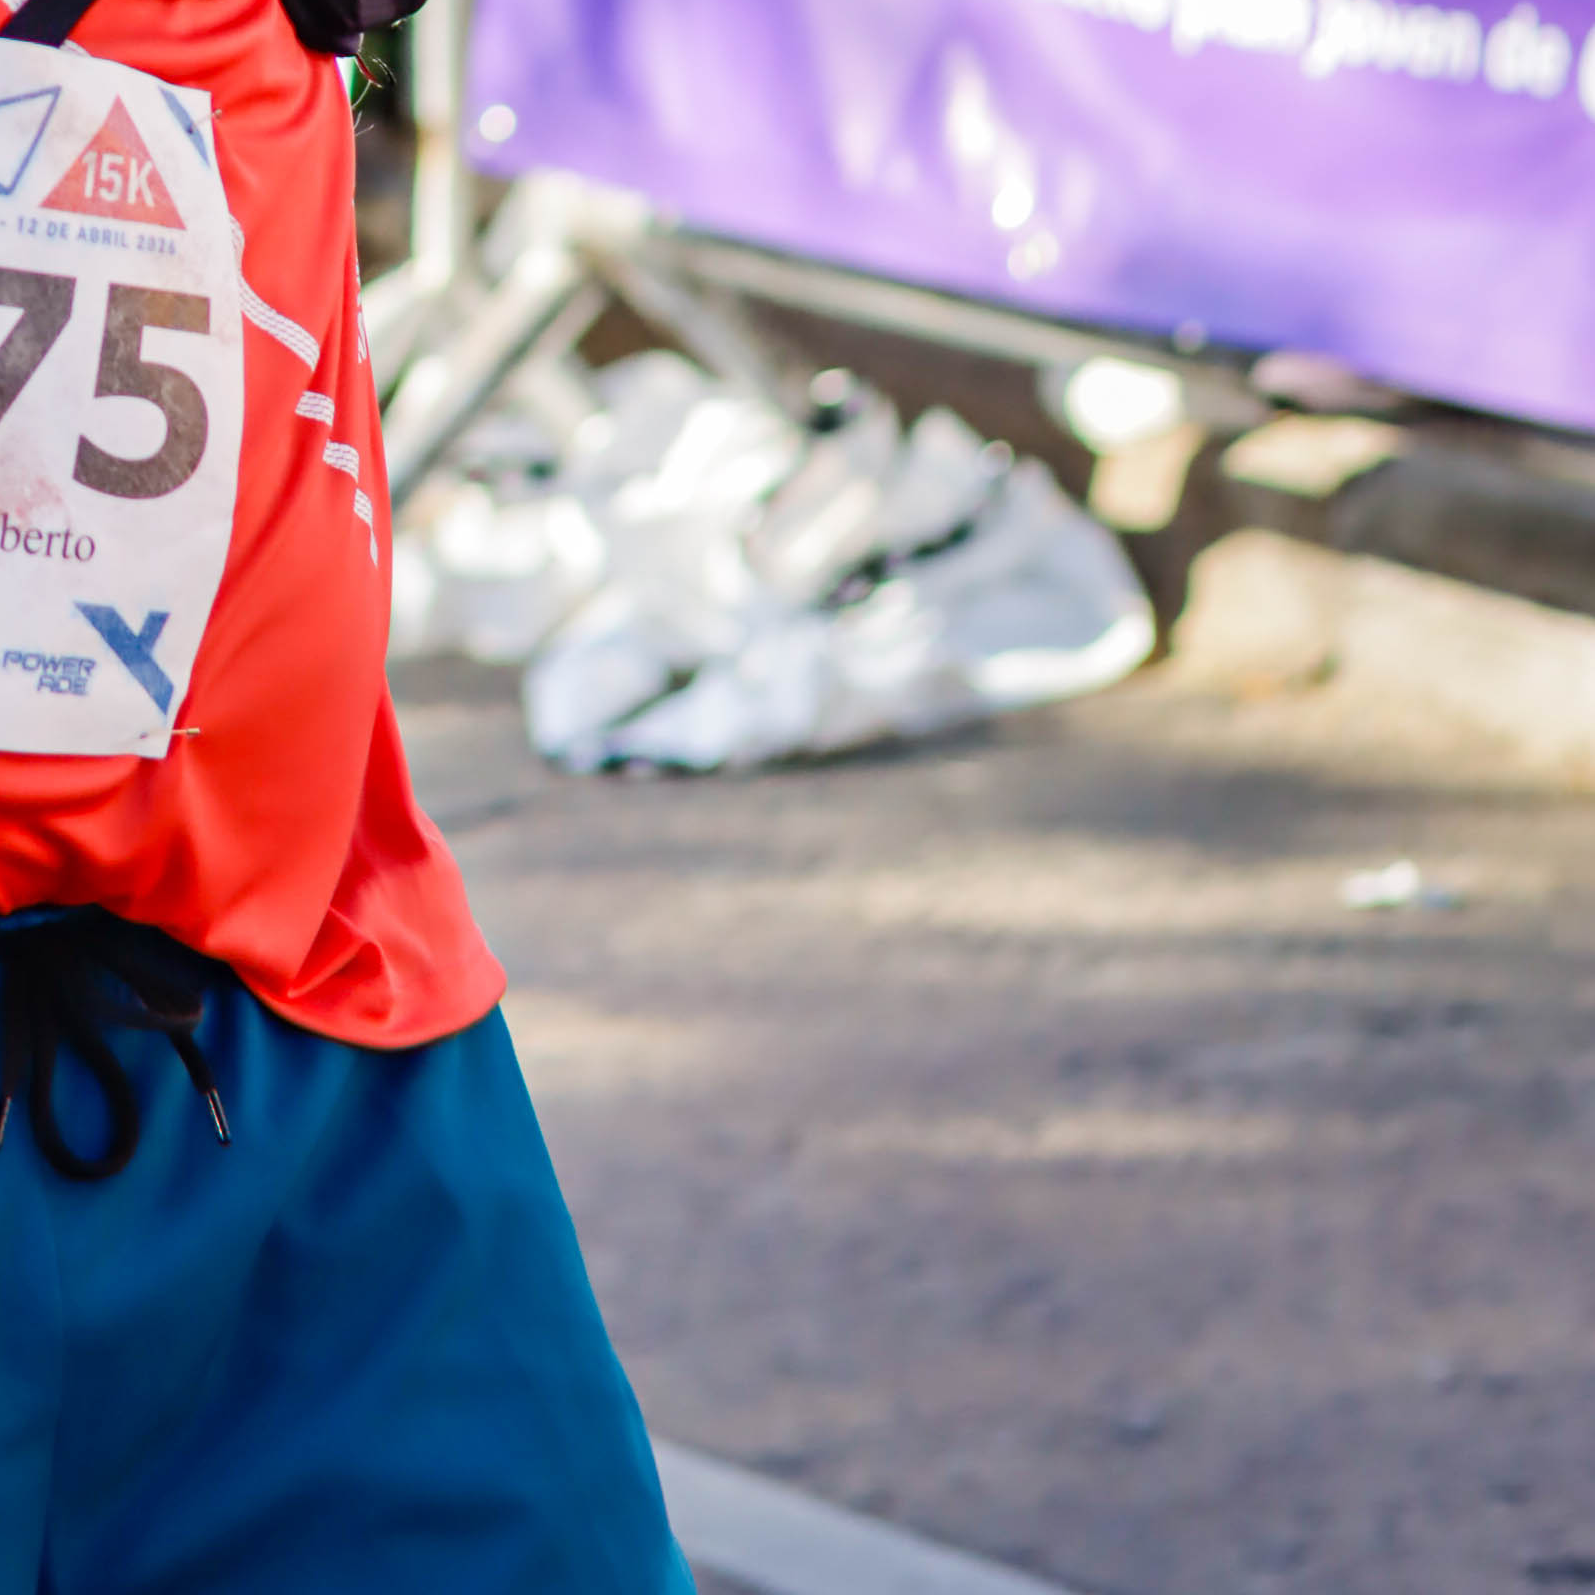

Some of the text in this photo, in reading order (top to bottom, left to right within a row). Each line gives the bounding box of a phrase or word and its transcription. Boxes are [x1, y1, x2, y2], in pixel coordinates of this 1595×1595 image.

[81, 151, 155, 208] 15K
[46, 219, 70, 241] DE
[77, 226, 128, 249] ABRIL
[2, 649, 98, 677] POWER
